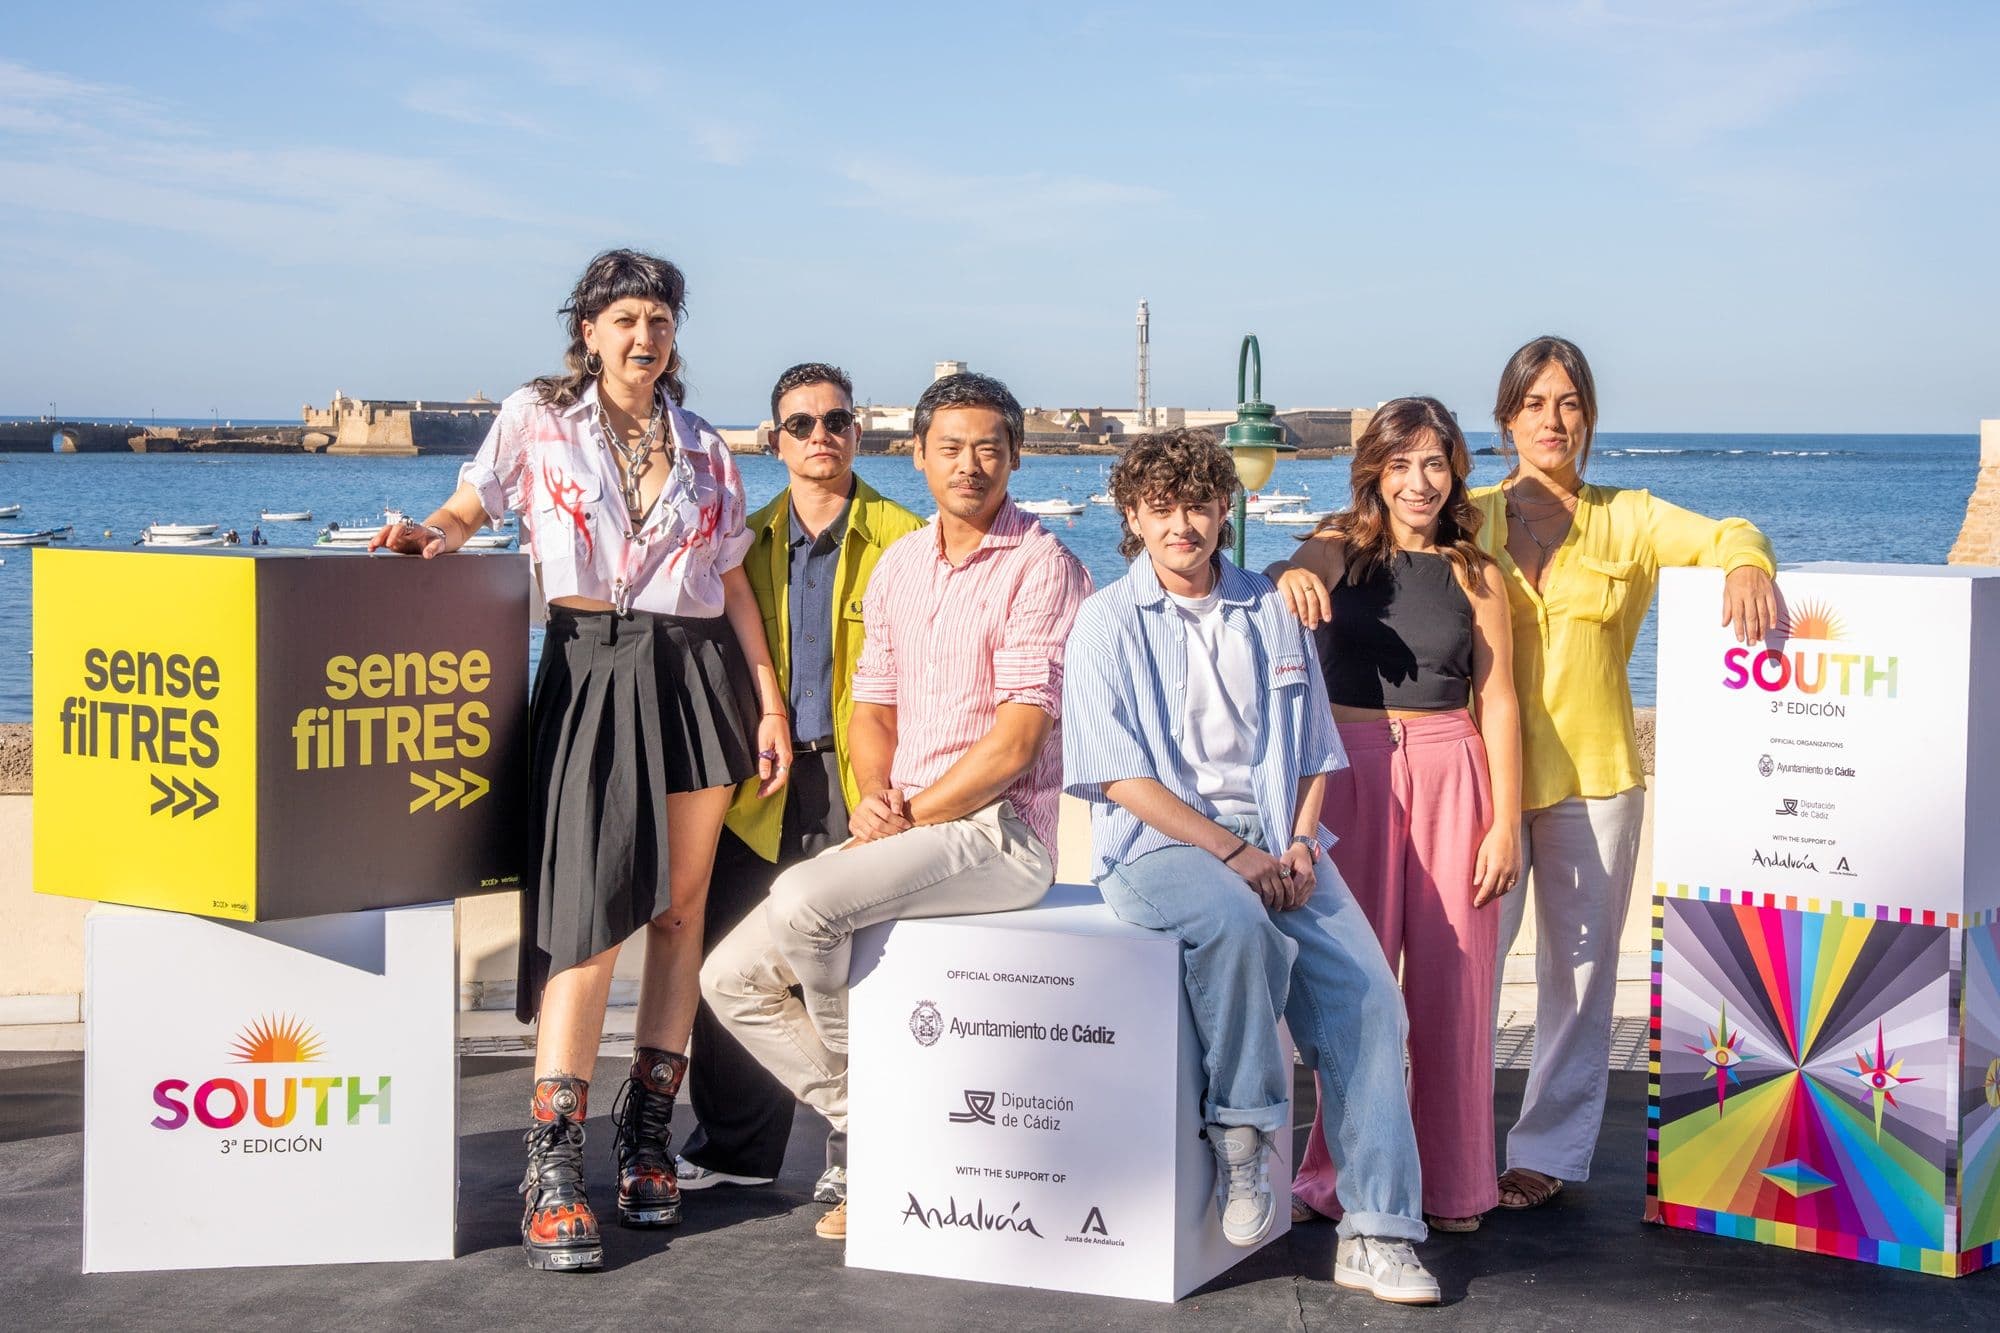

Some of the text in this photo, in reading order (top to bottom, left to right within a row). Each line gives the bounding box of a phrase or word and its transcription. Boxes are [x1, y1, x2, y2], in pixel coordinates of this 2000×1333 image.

[84, 647, 221, 701] sense
[325, 649, 492, 701] sense
[1722, 647, 1898, 699] SOUTH
[1787, 700, 1845, 717] EDICIÓN
[60, 696, 221, 769] filTRES
[292, 700, 491, 770] filTRES
[1770, 737, 1843, 749] OFFICIAL ORGANIZATIONS
[1777, 762, 1823, 776] Ayuntamiento
[1825, 767, 1834, 776] de
[1800, 799, 1835, 811] Diputación
[1800, 810, 1809, 818] de
[1801, 837, 1826, 845] SUPPORT
[1752, 849, 1819, 873] Andalucía
[947, 970, 1075, 986] OFFICIAL ORGANIZATIONS
[950, 1016, 1115, 1045] Ayuntamiento de Cádiz
[150, 1076, 392, 1131] SOUTH
[1001, 1092, 1074, 1113] Diputación
[1001, 1113, 1061, 1131] de Cádiz
[242, 1135, 323, 1153] EDICIÓN
[955, 1166, 1067, 1183] WITH THE SUPPORT OF
[901, 1191, 1045, 1239] Andalucía
[1064, 1235, 1082, 1243] Junta
[1093, 1238, 1125, 1247] Andalucía
